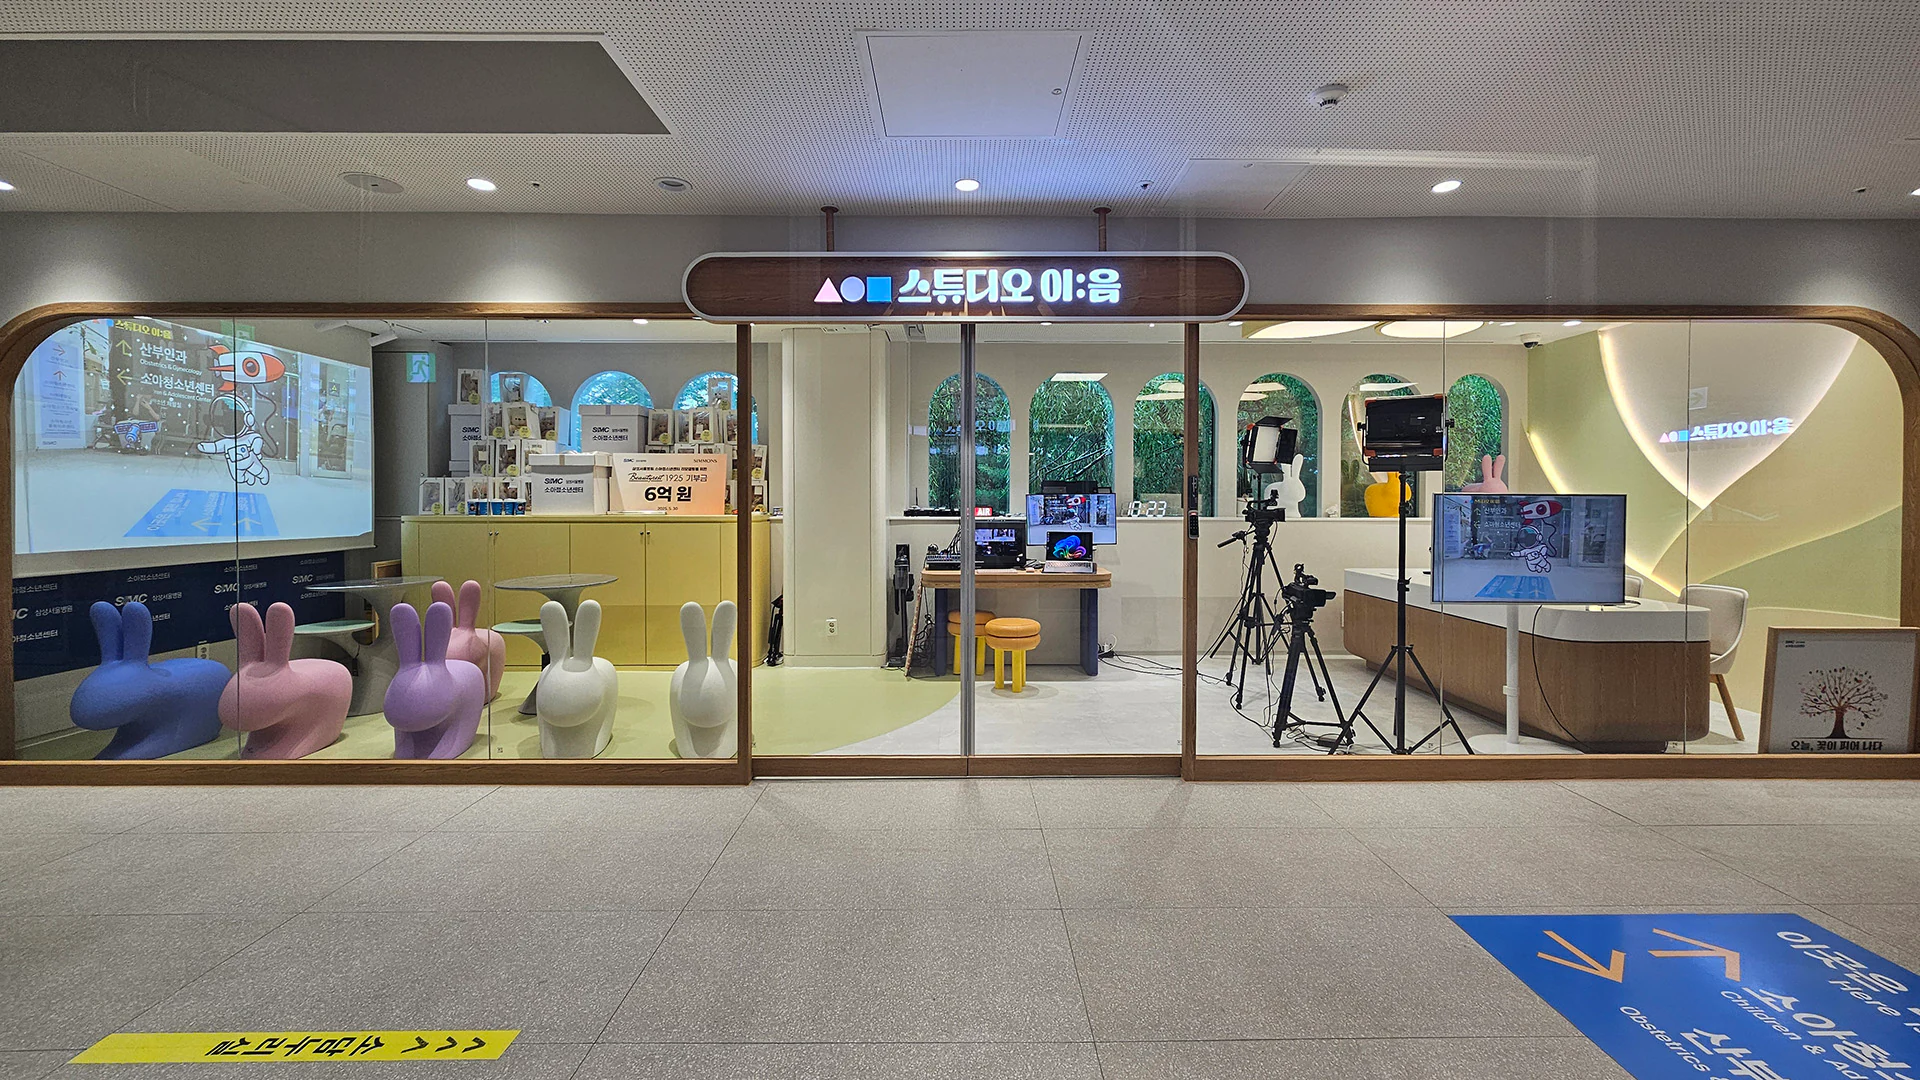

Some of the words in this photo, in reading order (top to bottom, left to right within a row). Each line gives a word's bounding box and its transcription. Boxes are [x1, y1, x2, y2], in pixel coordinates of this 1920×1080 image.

[898, 268, 1034, 304] 스튜디오
[1040, 268, 1122, 304] 이:음
[115, 319, 150, 335] 스튜디오
[140, 342, 188, 364] 산부인과
[140, 372, 215, 397] 소아청소년센터
[1689, 420, 1750, 441] 스튜디오
[686, 474, 707, 482] 기부금
[644, 486, 672, 502] 6억
[677, 486, 692, 502] 원
[1790, 740, 1814, 751] 오늘,
[1816, 740, 1837, 751] 꽃이
[1839, 740, 1860, 751] 피어
[1862, 740, 1883, 751] 나다
[1776, 931, 1909, 994] 이곳은
[1828, 980, 1901, 1017] Here
[1720, 990, 1802, 1041] Children
[1802, 1044, 1827, 1055] &
[205, 1035, 385, 1056] 소담누리실
[1619, 1006, 1711, 1072] Obstetrics
